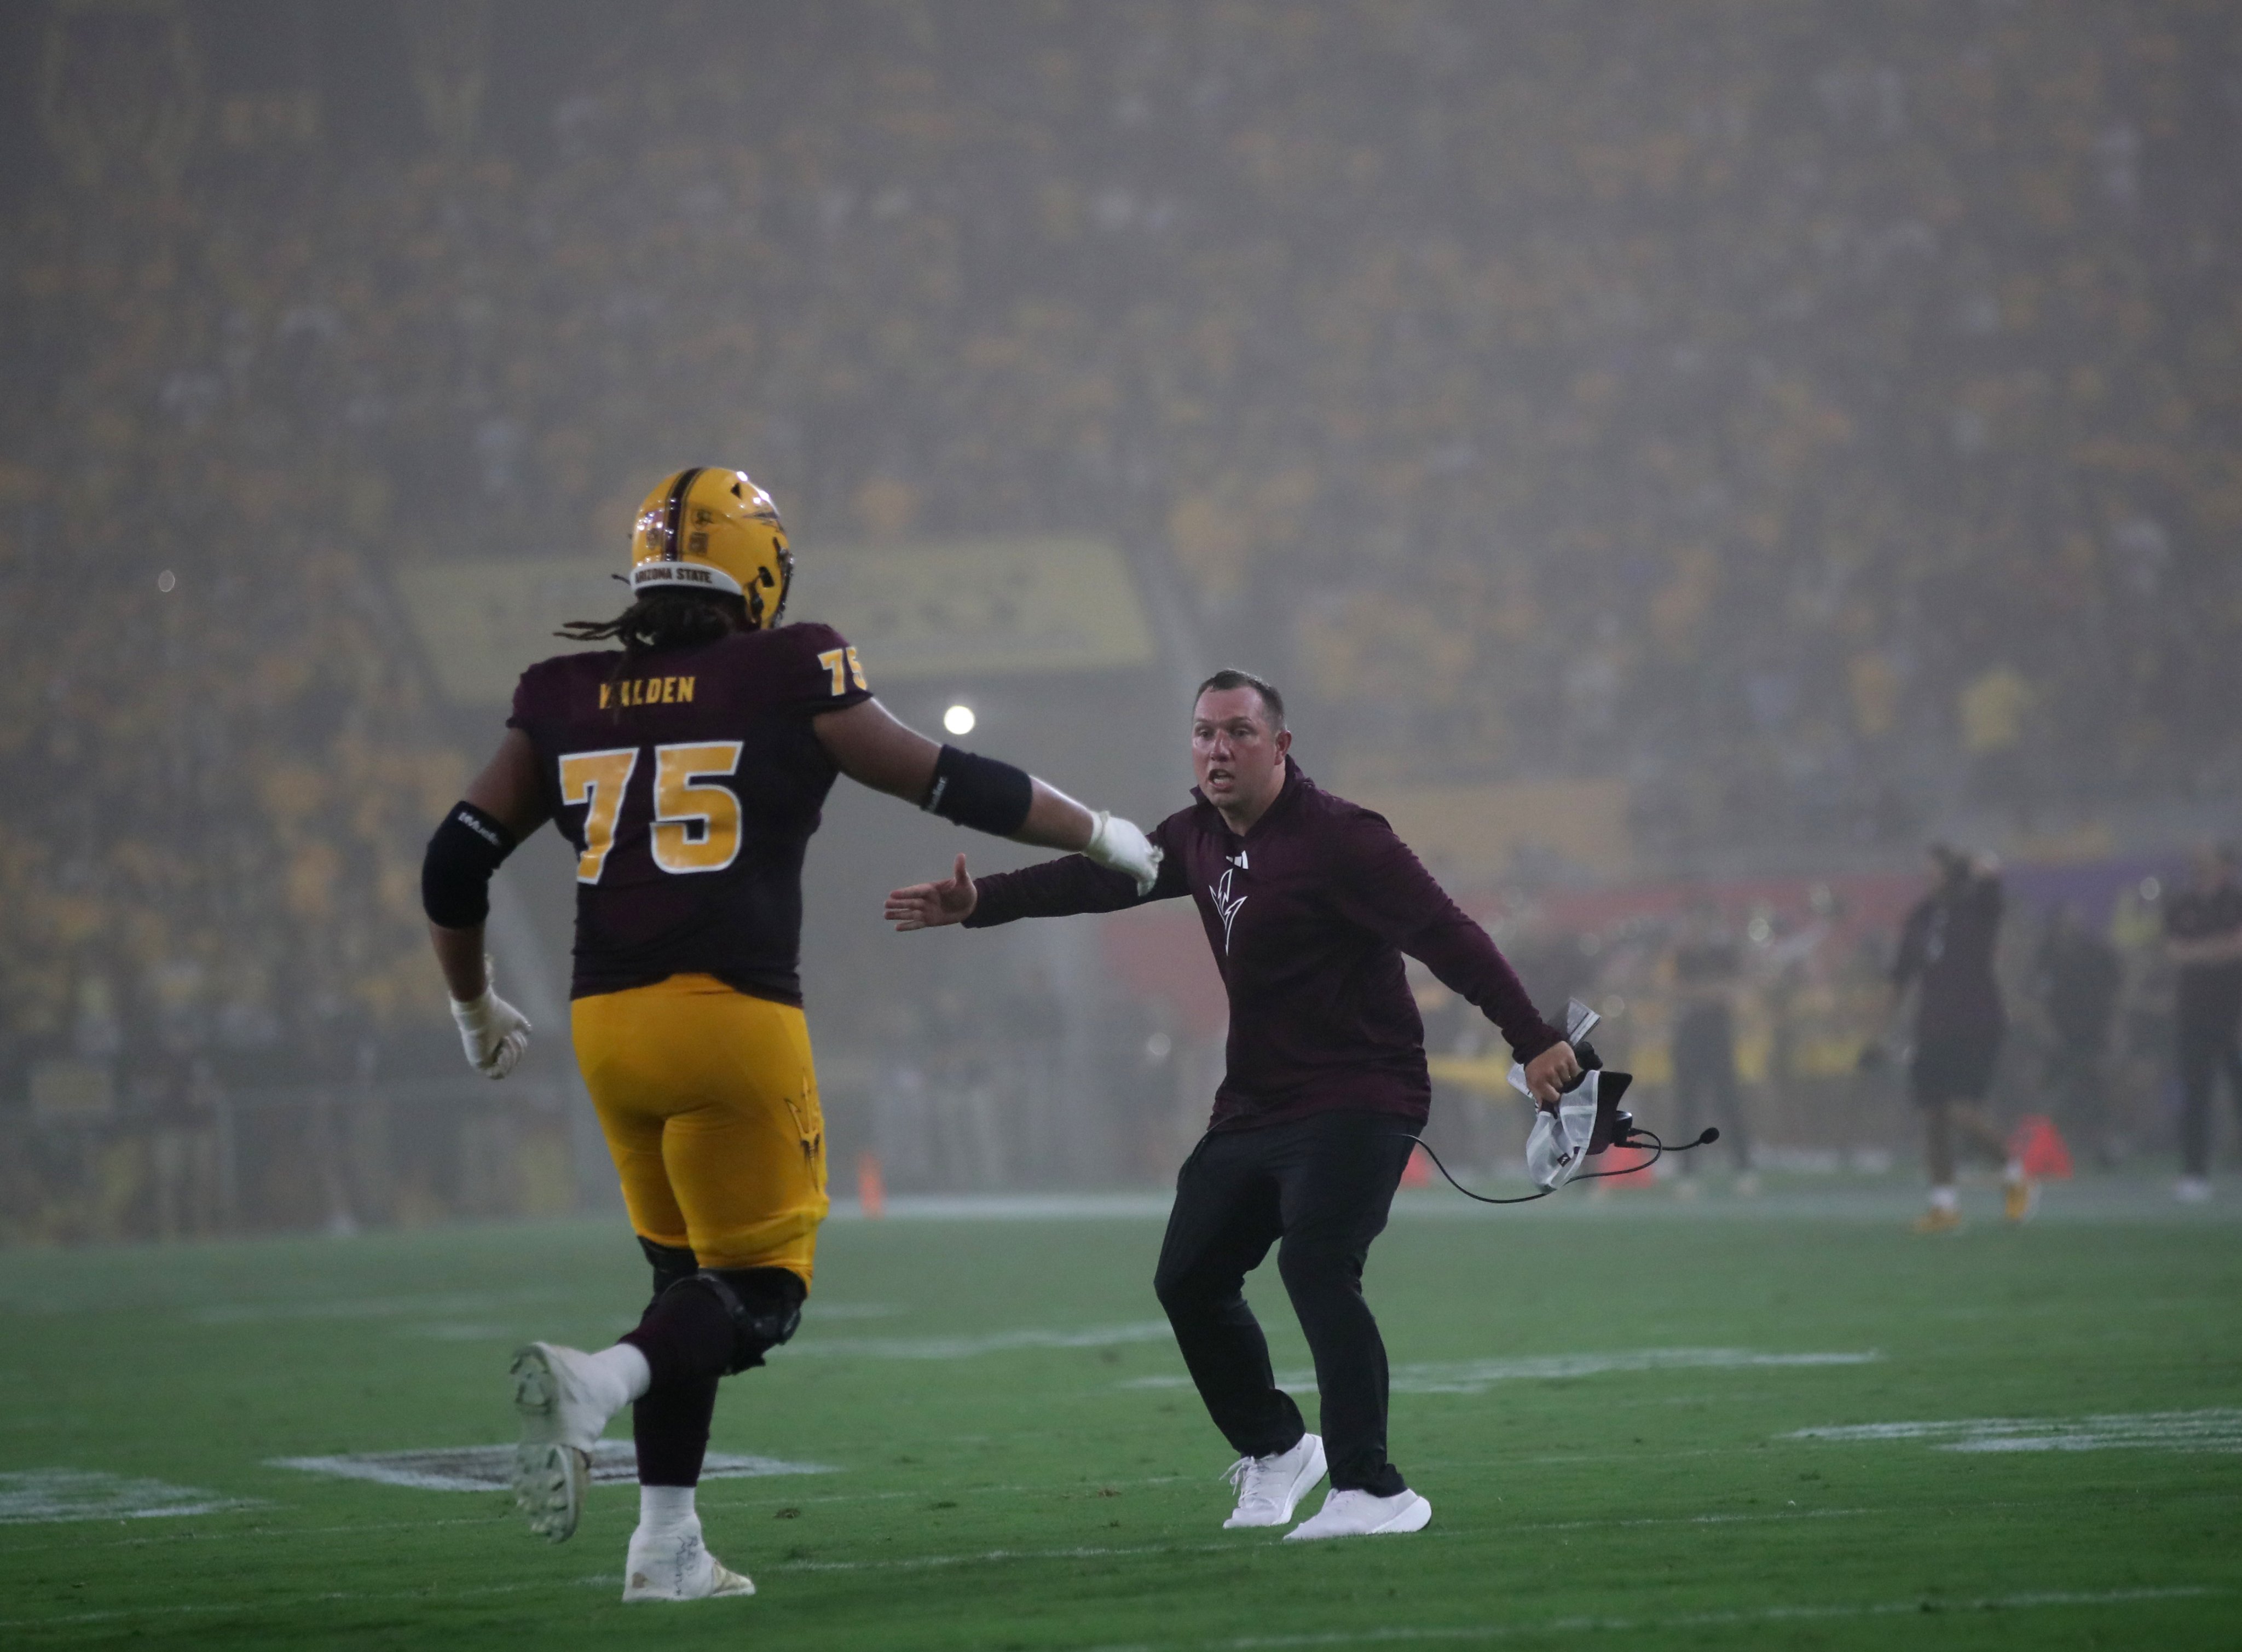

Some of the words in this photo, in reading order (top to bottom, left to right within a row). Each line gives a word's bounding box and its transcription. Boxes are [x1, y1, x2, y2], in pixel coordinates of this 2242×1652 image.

[635, 568, 672, 584] ARIZONA
[677, 568, 712, 584] STATE
[817, 645, 868, 696] 75
[558, 741, 744, 885] 75
